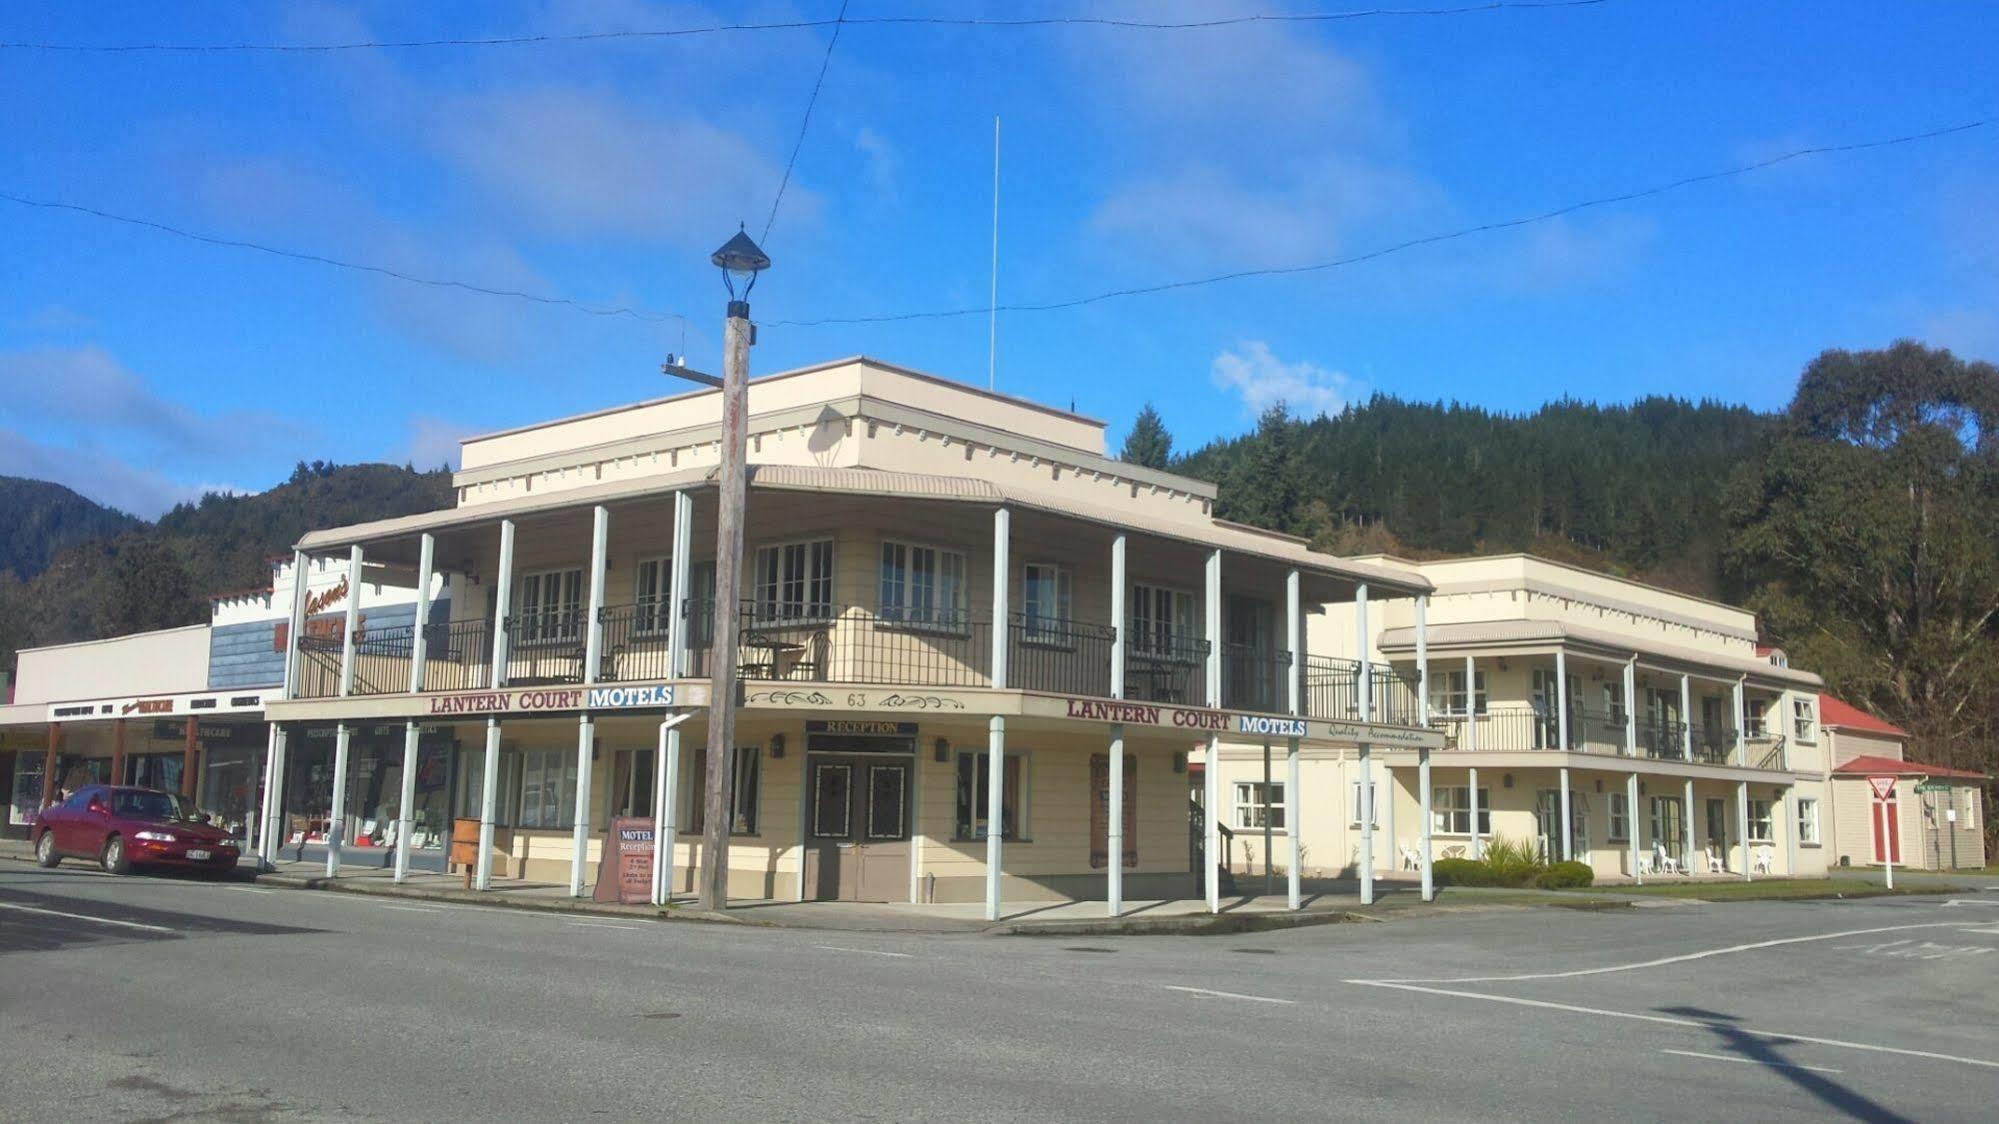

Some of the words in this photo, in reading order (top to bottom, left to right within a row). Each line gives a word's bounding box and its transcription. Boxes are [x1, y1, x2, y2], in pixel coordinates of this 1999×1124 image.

[430, 693, 512, 713] LANTERN
[519, 690, 582, 709] COURT
[589, 686, 673, 707] MOTELS
[847, 693, 866, 707] 63
[1066, 700, 1161, 725] LANTERN
[1172, 710, 1232, 730] COURT
[1241, 715, 1306, 736] MOTELS
[827, 721, 897, 733] RECEPTION
[1328, 723, 1359, 739] Quality
[621, 830, 654, 840] MOTEL
